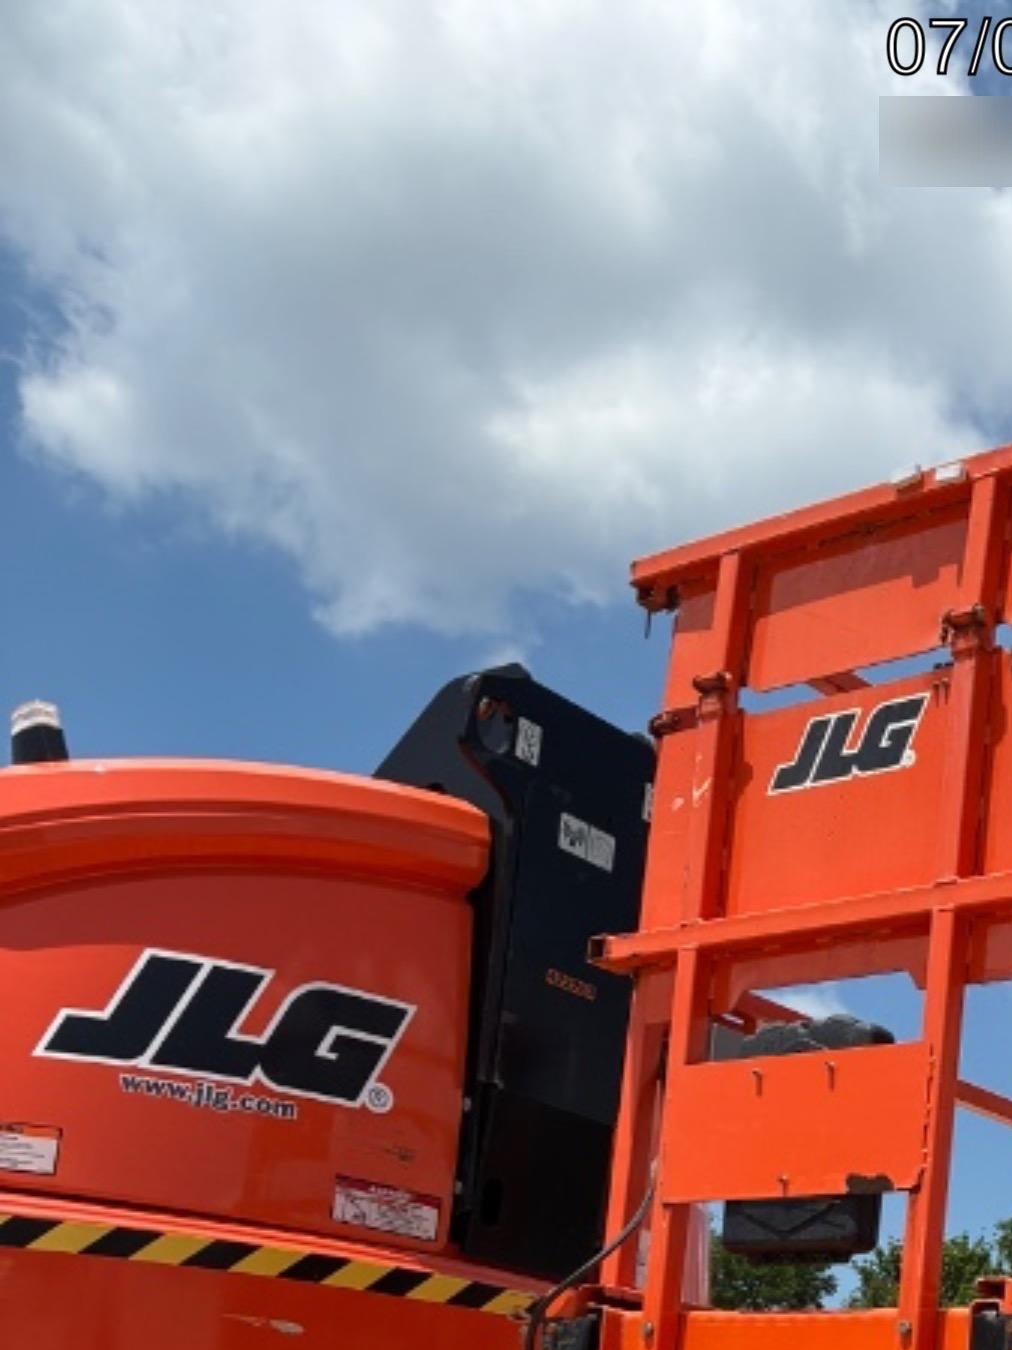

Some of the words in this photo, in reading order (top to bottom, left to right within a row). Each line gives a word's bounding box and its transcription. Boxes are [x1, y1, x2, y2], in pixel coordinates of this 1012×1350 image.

[768, 692, 931, 796] JLG
[32, 947, 417, 1107] JLG
[120, 1074, 297, 1119] www.jlg.com
